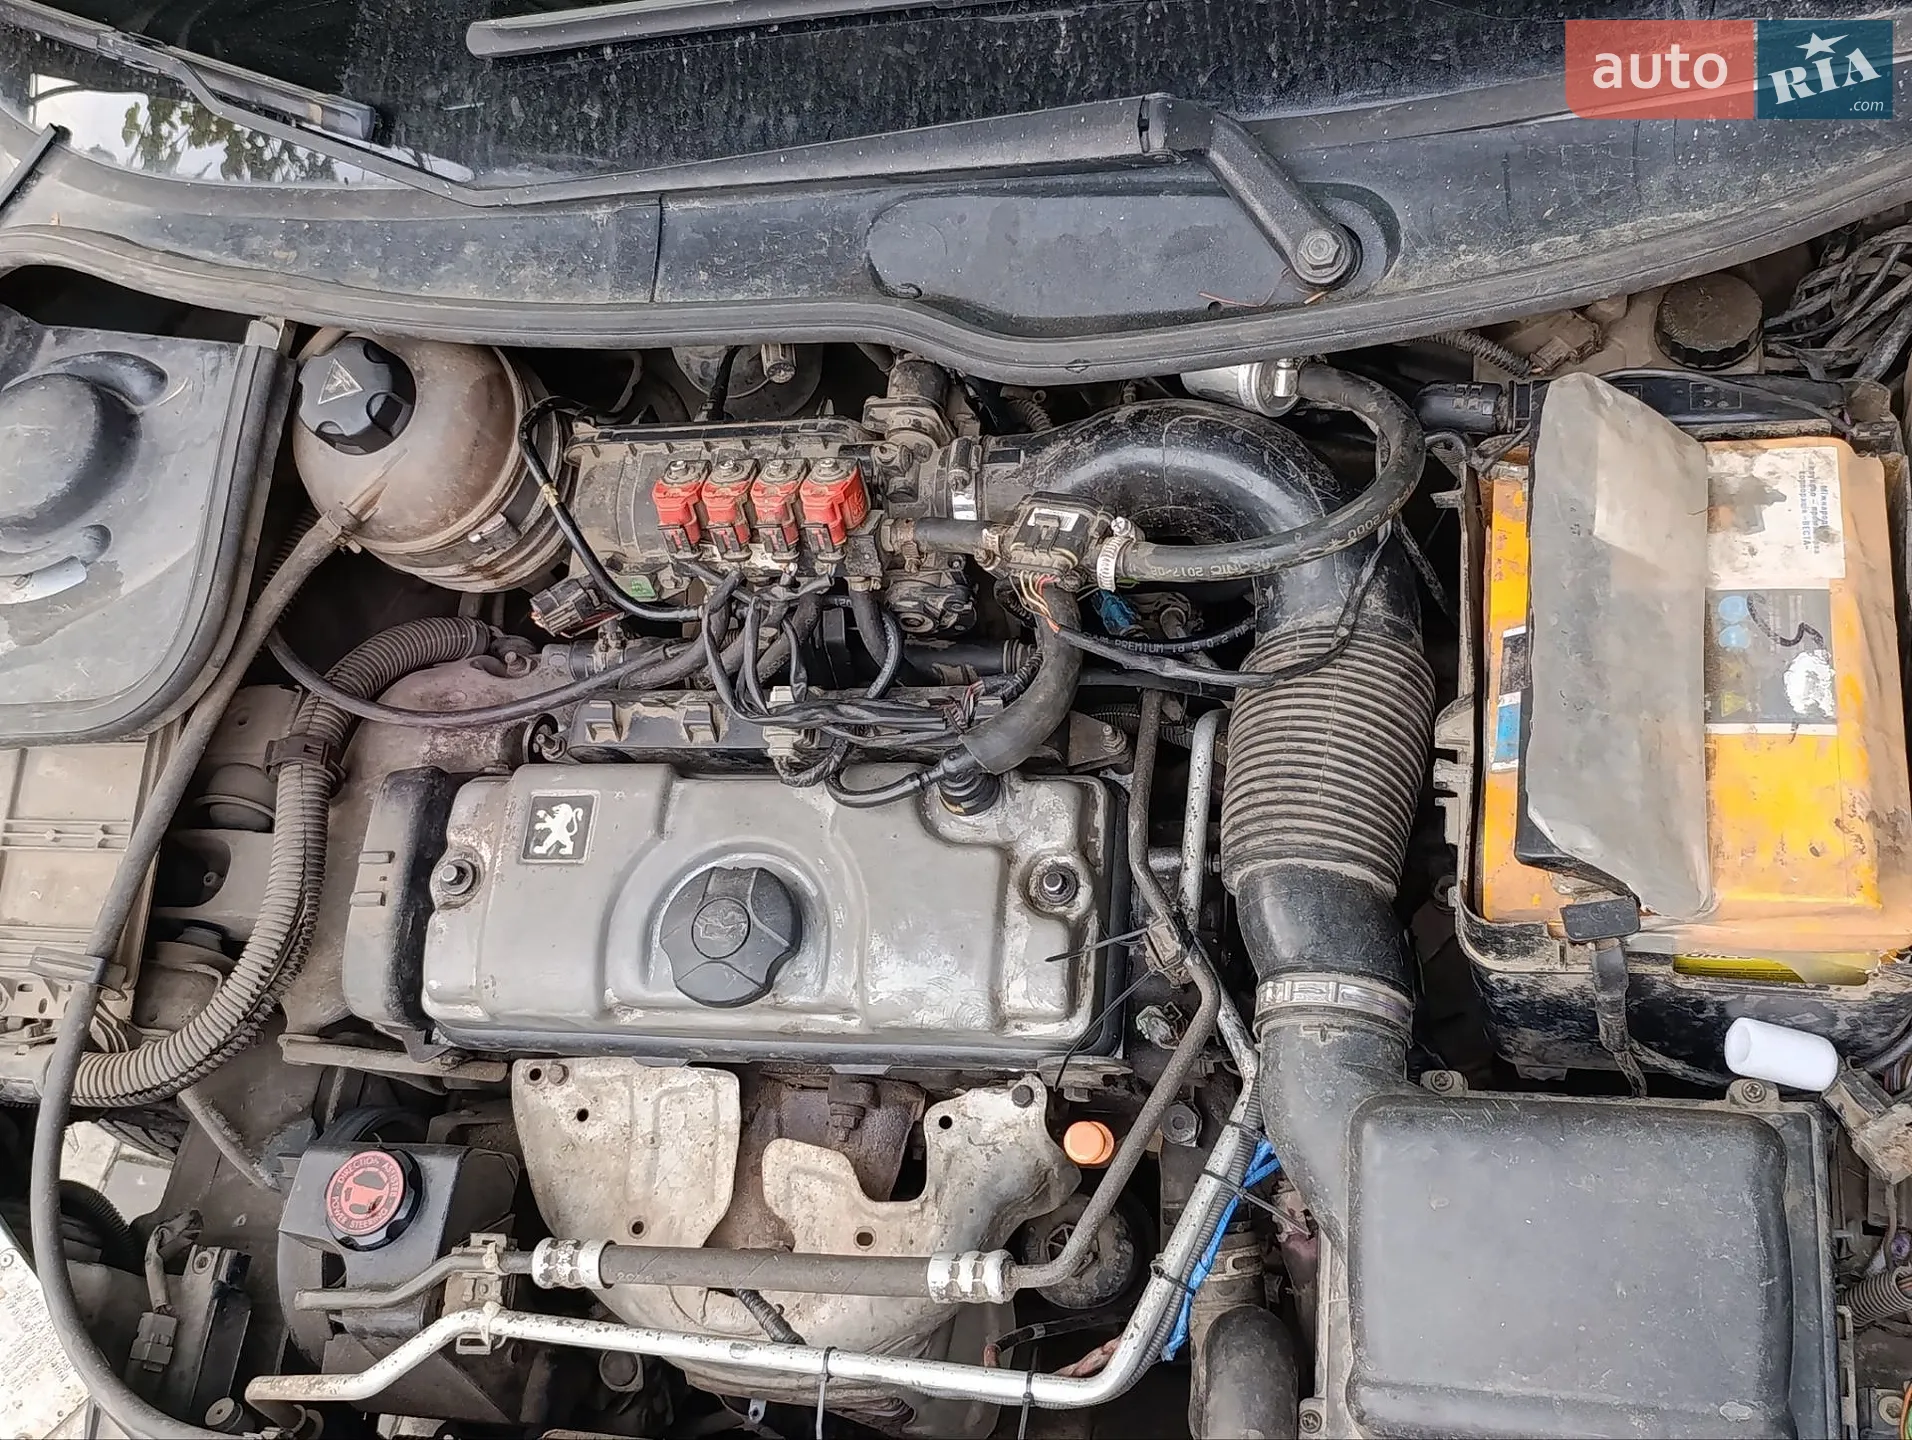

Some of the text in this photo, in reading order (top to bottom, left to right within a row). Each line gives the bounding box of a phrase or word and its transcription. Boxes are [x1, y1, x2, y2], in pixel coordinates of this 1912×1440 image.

[1115, 638, 1164, 654] PREMIUM
[331, 1194, 389, 1229] POWER STEERING
